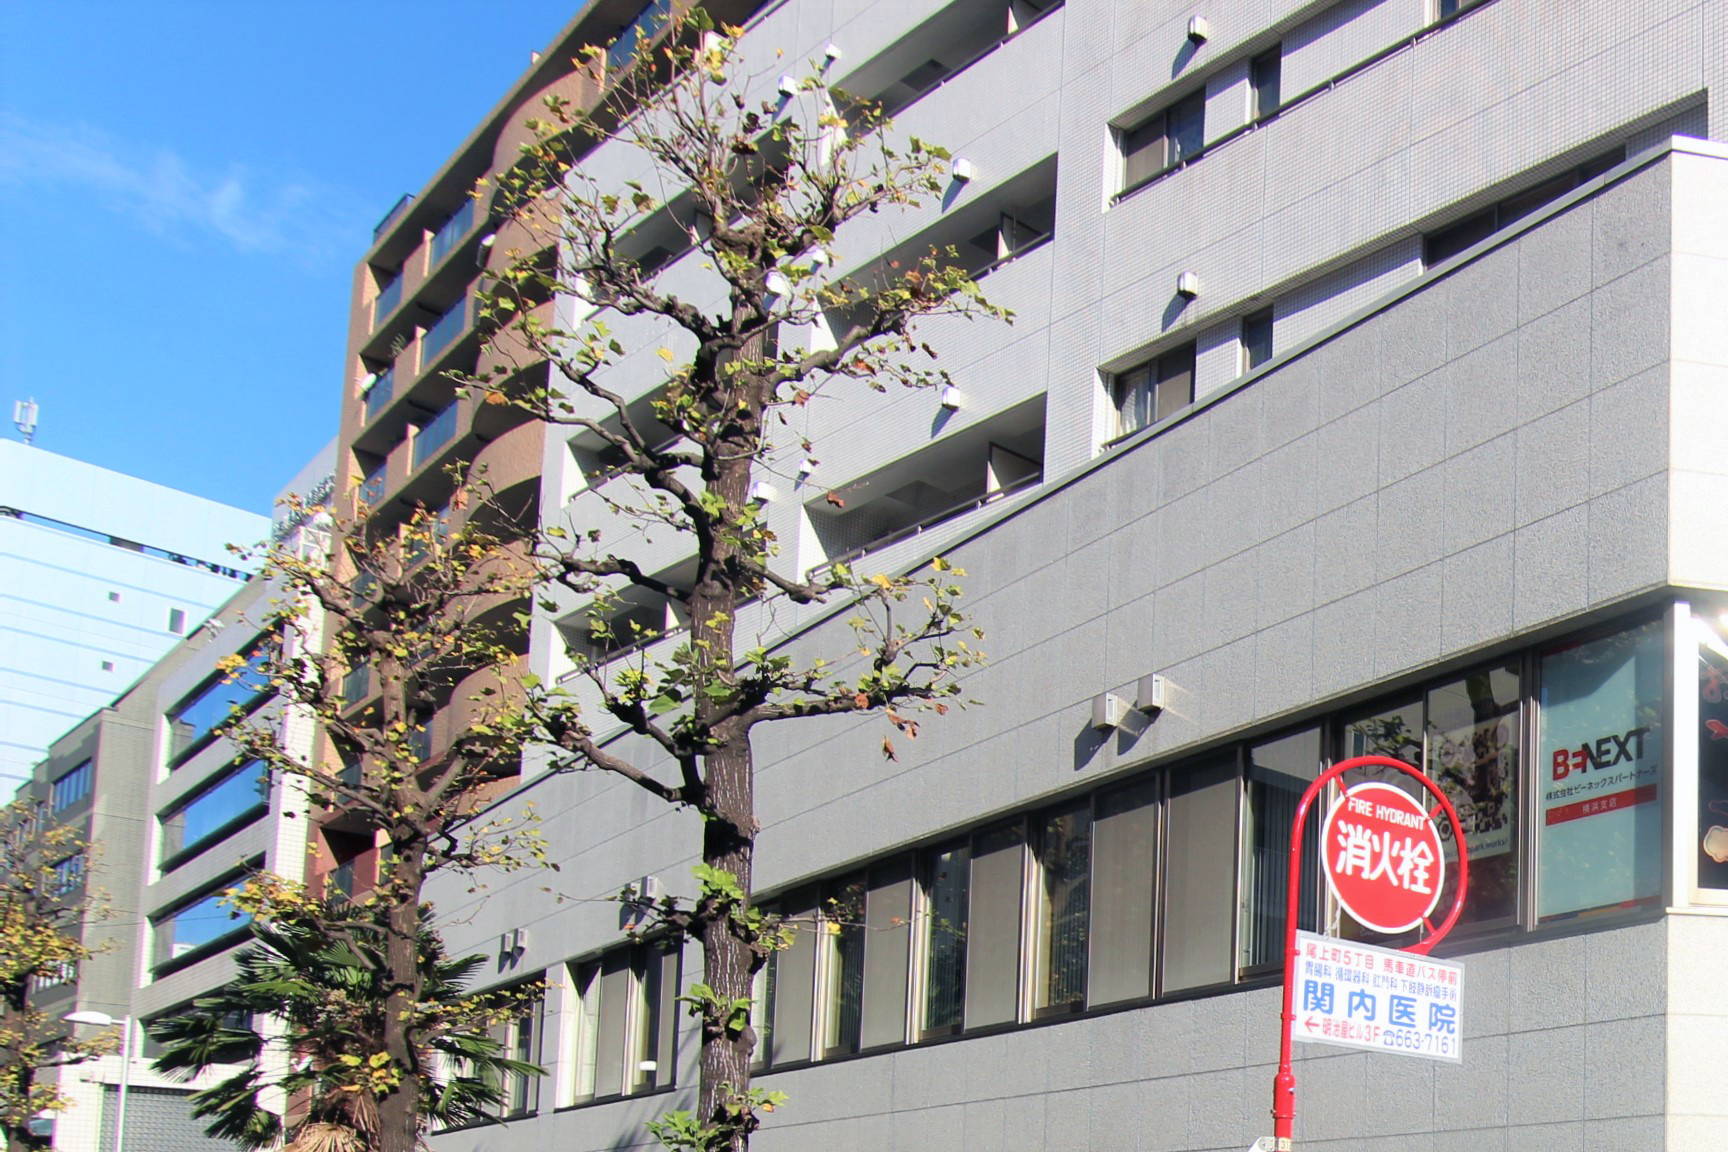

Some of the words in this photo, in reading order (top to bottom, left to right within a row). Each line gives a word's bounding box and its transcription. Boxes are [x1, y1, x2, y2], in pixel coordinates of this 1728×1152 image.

[1348, 796, 1373, 817] FIRE
[1376, 804, 1426, 831] HYDRANT
[1582, 797, 1617, 814] 横浜支店
[1336, 819, 1435, 895] 消火栓
[1306, 942, 1374, 970] 尾上町5丁目
[1383, 957, 1458, 986] 馬車道バス停前
[1372, 974, 1399, 991] 肛門科
[1303, 978, 1457, 1035] 関内医院
